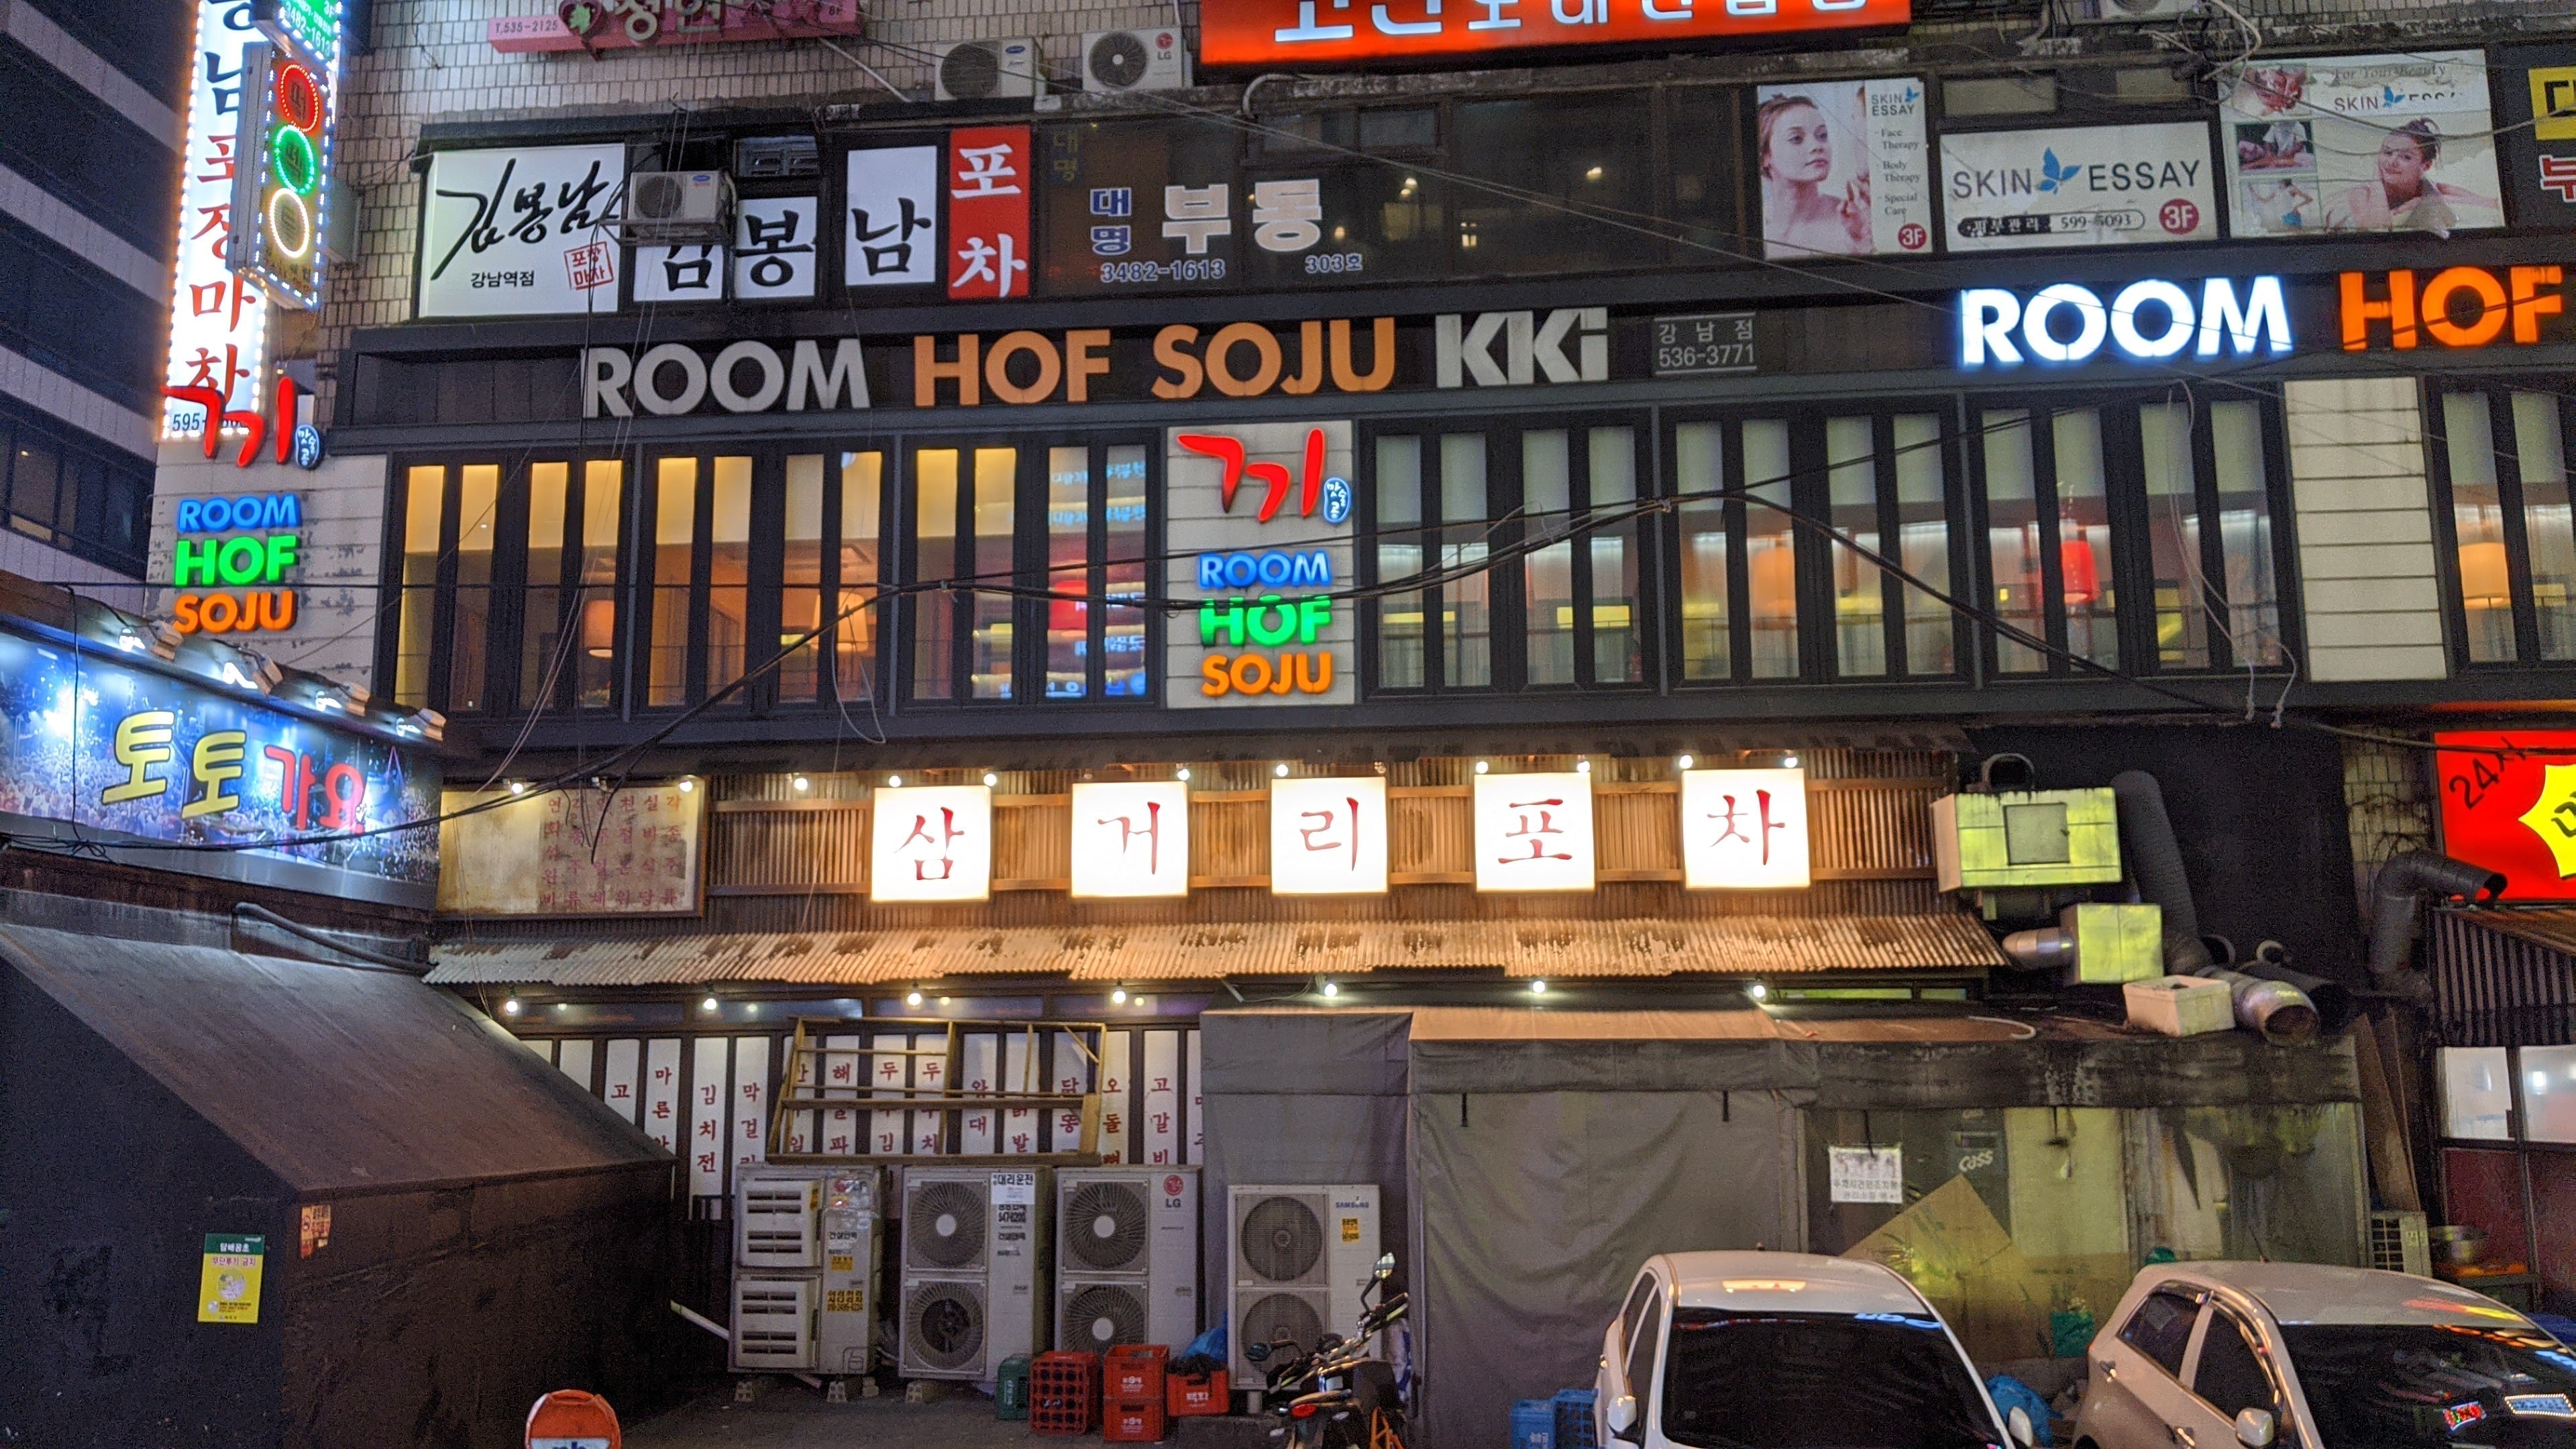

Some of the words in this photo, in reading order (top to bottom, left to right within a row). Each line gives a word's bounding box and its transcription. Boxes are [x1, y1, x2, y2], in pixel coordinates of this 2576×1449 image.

[1158, 52, 1172, 60] LG
[1872, 93, 1902, 105] SKIN
[1872, 104, 1915, 117] ESSAY
[2334, 96, 2379, 112] SKIN
[1882, 140, 1919, 151] Therapy
[1882, 160, 1907, 171] Body
[1884, 172, 1921, 184] Therapy
[1953, 168, 2033, 200] SKIN
[2089, 160, 2200, 193] ESSAY
[951, 144, 1028, 299] 포차
[1089, 187, 1132, 256] 대명
[1884, 206, 1907, 216] Care
[2164, 204, 2194, 230] 3F
[1901, 228, 1923, 246] 3F
[470, 270, 535, 288] 강남역점
[1100, 259, 1226, 283] 3482-1613
[1305, 252, 1364, 274] 303호
[1959, 275, 2294, 368] ROOM
[2339, 266, 2563, 352] HOF
[582, 338, 871, 418] ROOM
[914, 329, 1111, 407] HOF
[1150, 316, 1396, 399] SOJU
[1659, 343, 1755, 367] 536-3771
[178, 494, 300, 533] ROOM
[175, 535, 297, 586] HOF
[1198, 551, 1331, 589] ROOM
[172, 590, 295, 634] SOJU
[1199, 594, 1332, 647] HOF
[1201, 651, 1332, 697] SOJU
[697, 1084, 717, 1173] 김치전
[998, 1174, 1034, 1186] 대리운전
[1166, 1198, 1181, 1208] LG
